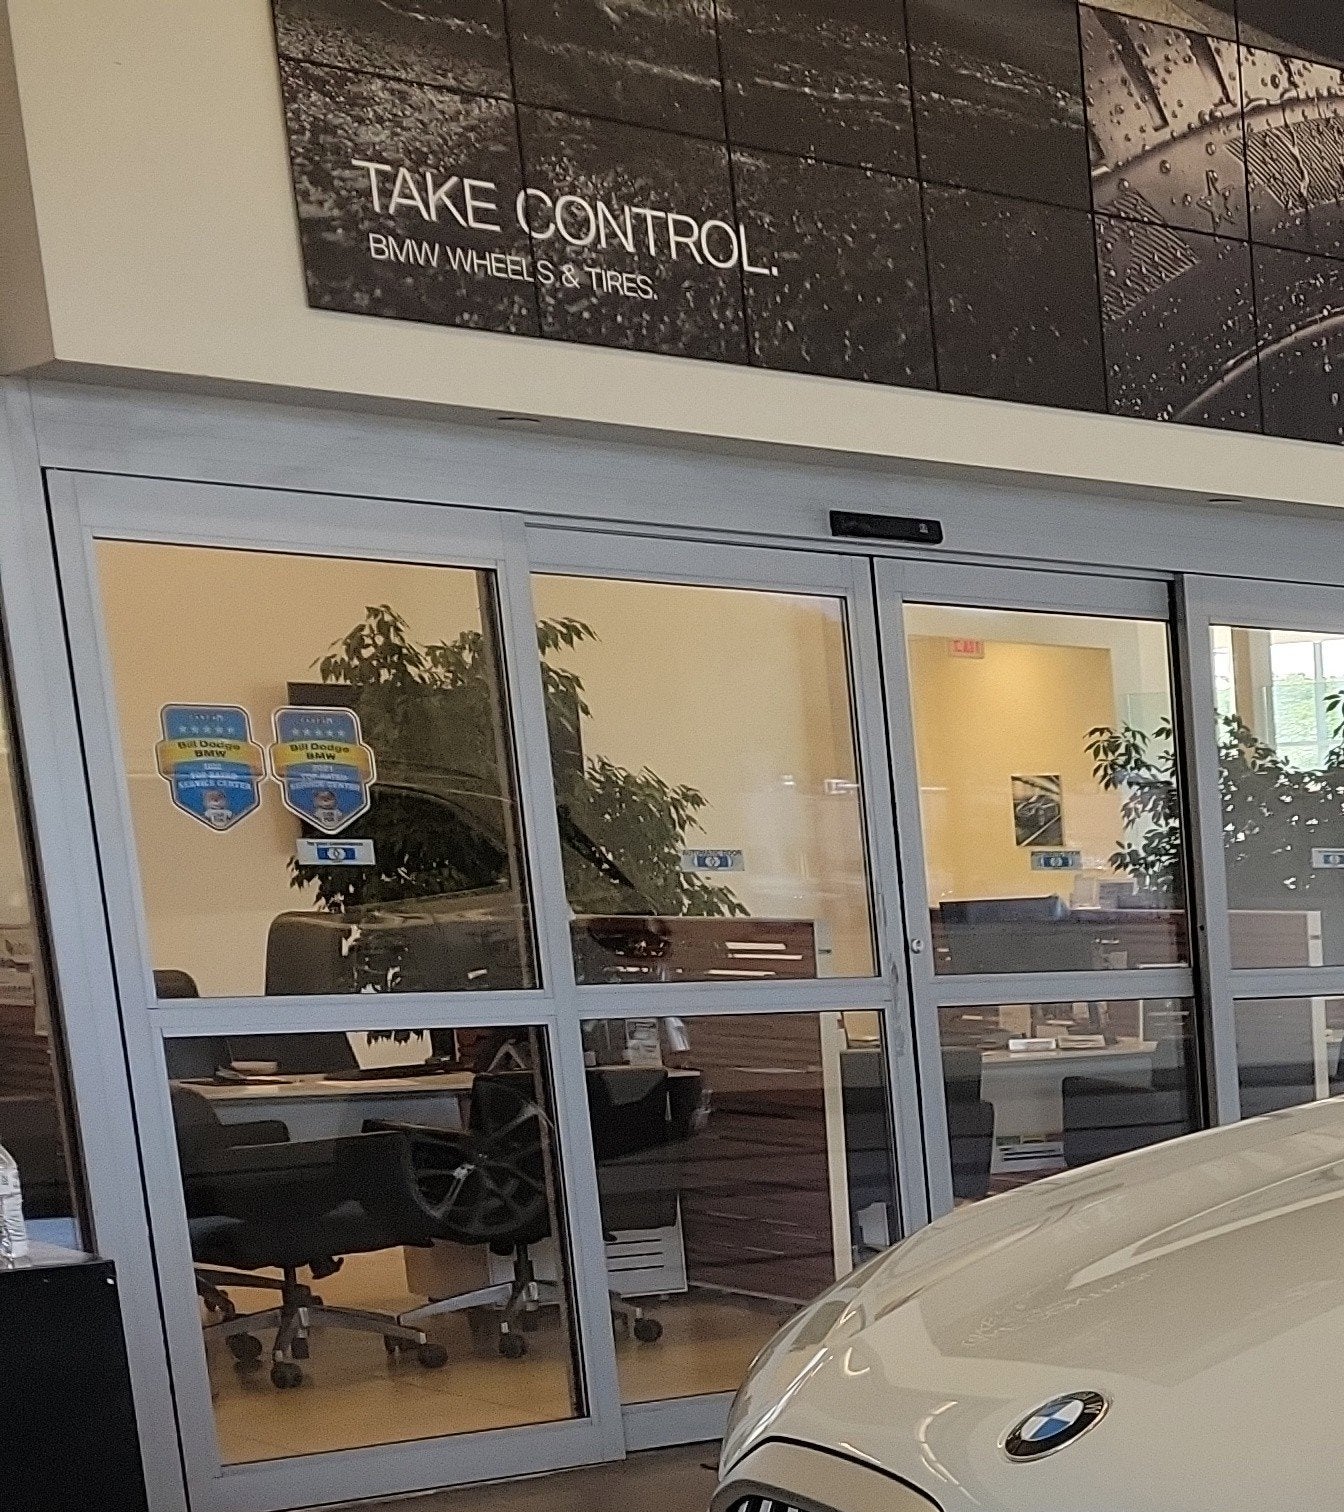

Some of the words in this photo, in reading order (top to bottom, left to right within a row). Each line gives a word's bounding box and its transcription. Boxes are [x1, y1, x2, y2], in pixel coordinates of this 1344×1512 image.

[351, 158, 501, 231] TAKE
[516, 187, 780, 277] CONTROL.
[368, 232, 440, 268] BMW
[446, 245, 556, 285] WHEELS
[561, 264, 582, 290] &
[586, 266, 660, 301] TIRES.
[177, 740, 197, 750] Bill
[199, 740, 241, 751] Dodge
[289, 742, 309, 752] Bill
[310, 742, 351, 754] Dodge
[194, 749, 227, 758] BMW
[306, 752, 336, 761] BMW
